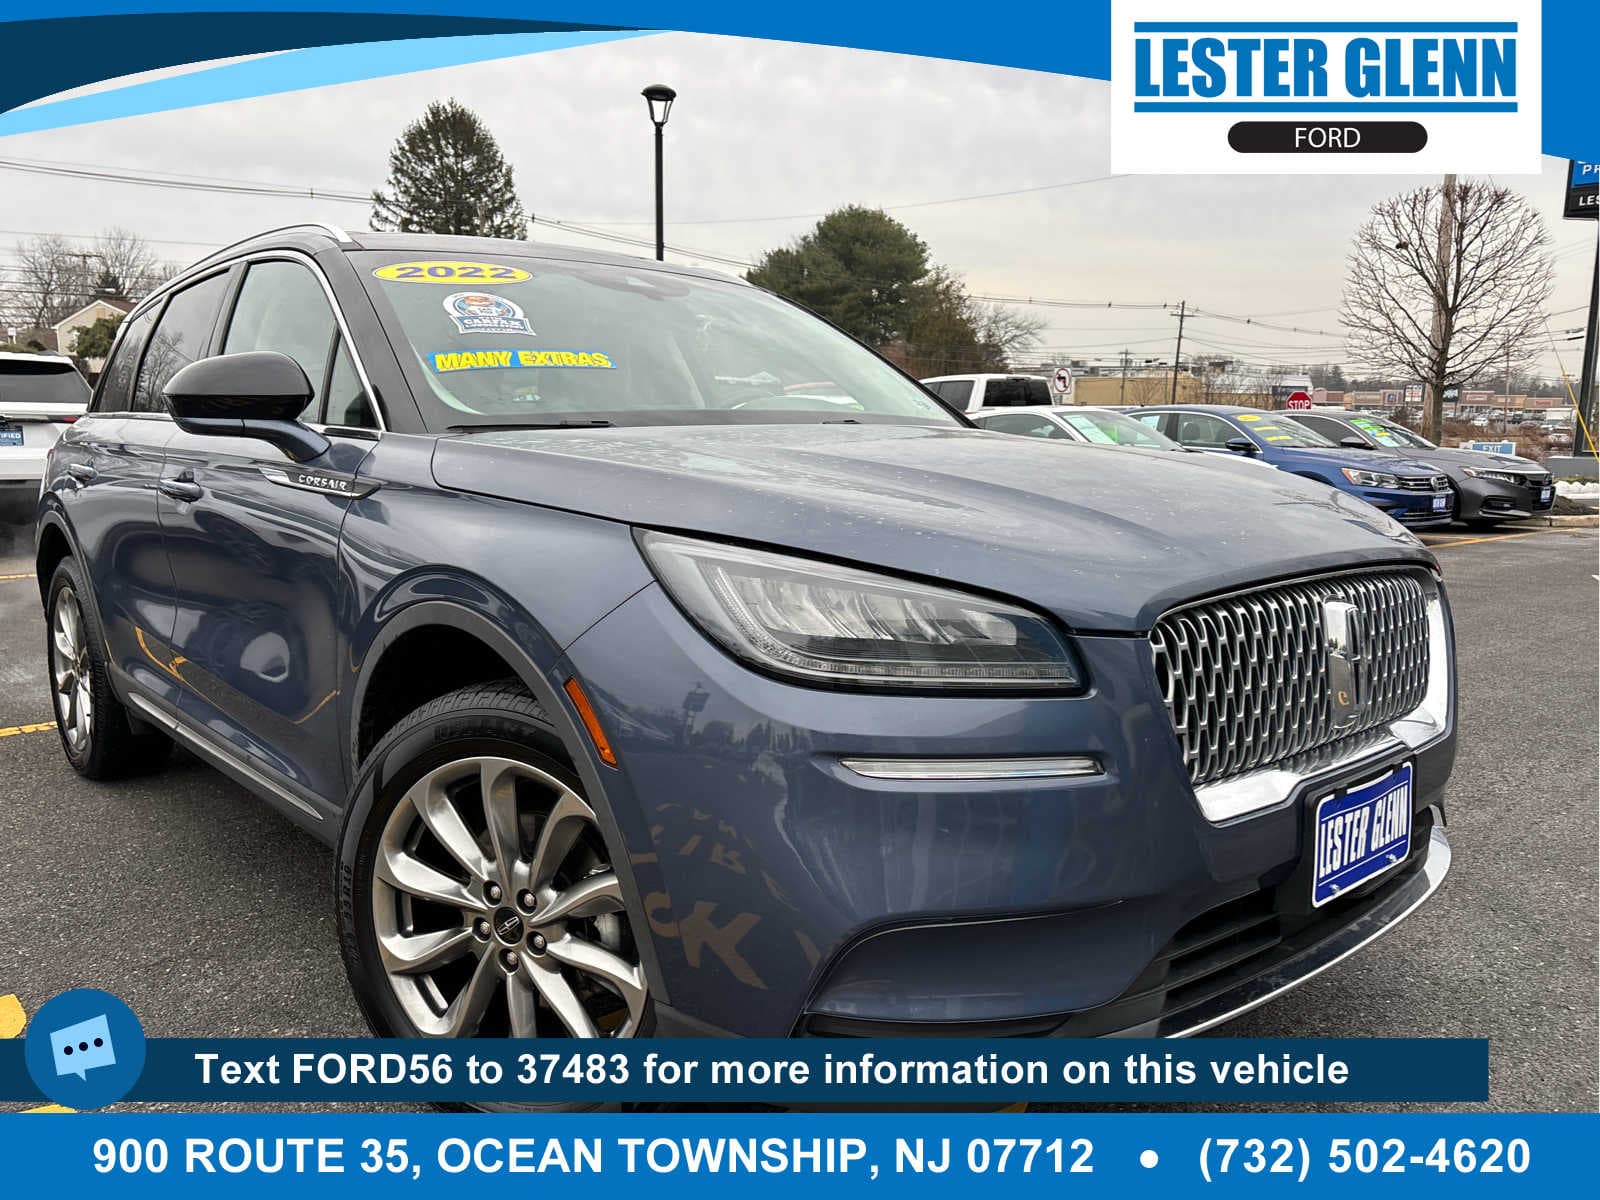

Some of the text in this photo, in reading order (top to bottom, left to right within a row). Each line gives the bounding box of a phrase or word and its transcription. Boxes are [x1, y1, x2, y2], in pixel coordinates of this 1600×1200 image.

[396, 265, 517, 279] 2022
[434, 350, 612, 371] MANY EXTRAS
[1288, 400, 1311, 410] STOP
[298, 474, 348, 491] CORSAIR
[1319, 784, 1408, 879] LESTER GLENN
